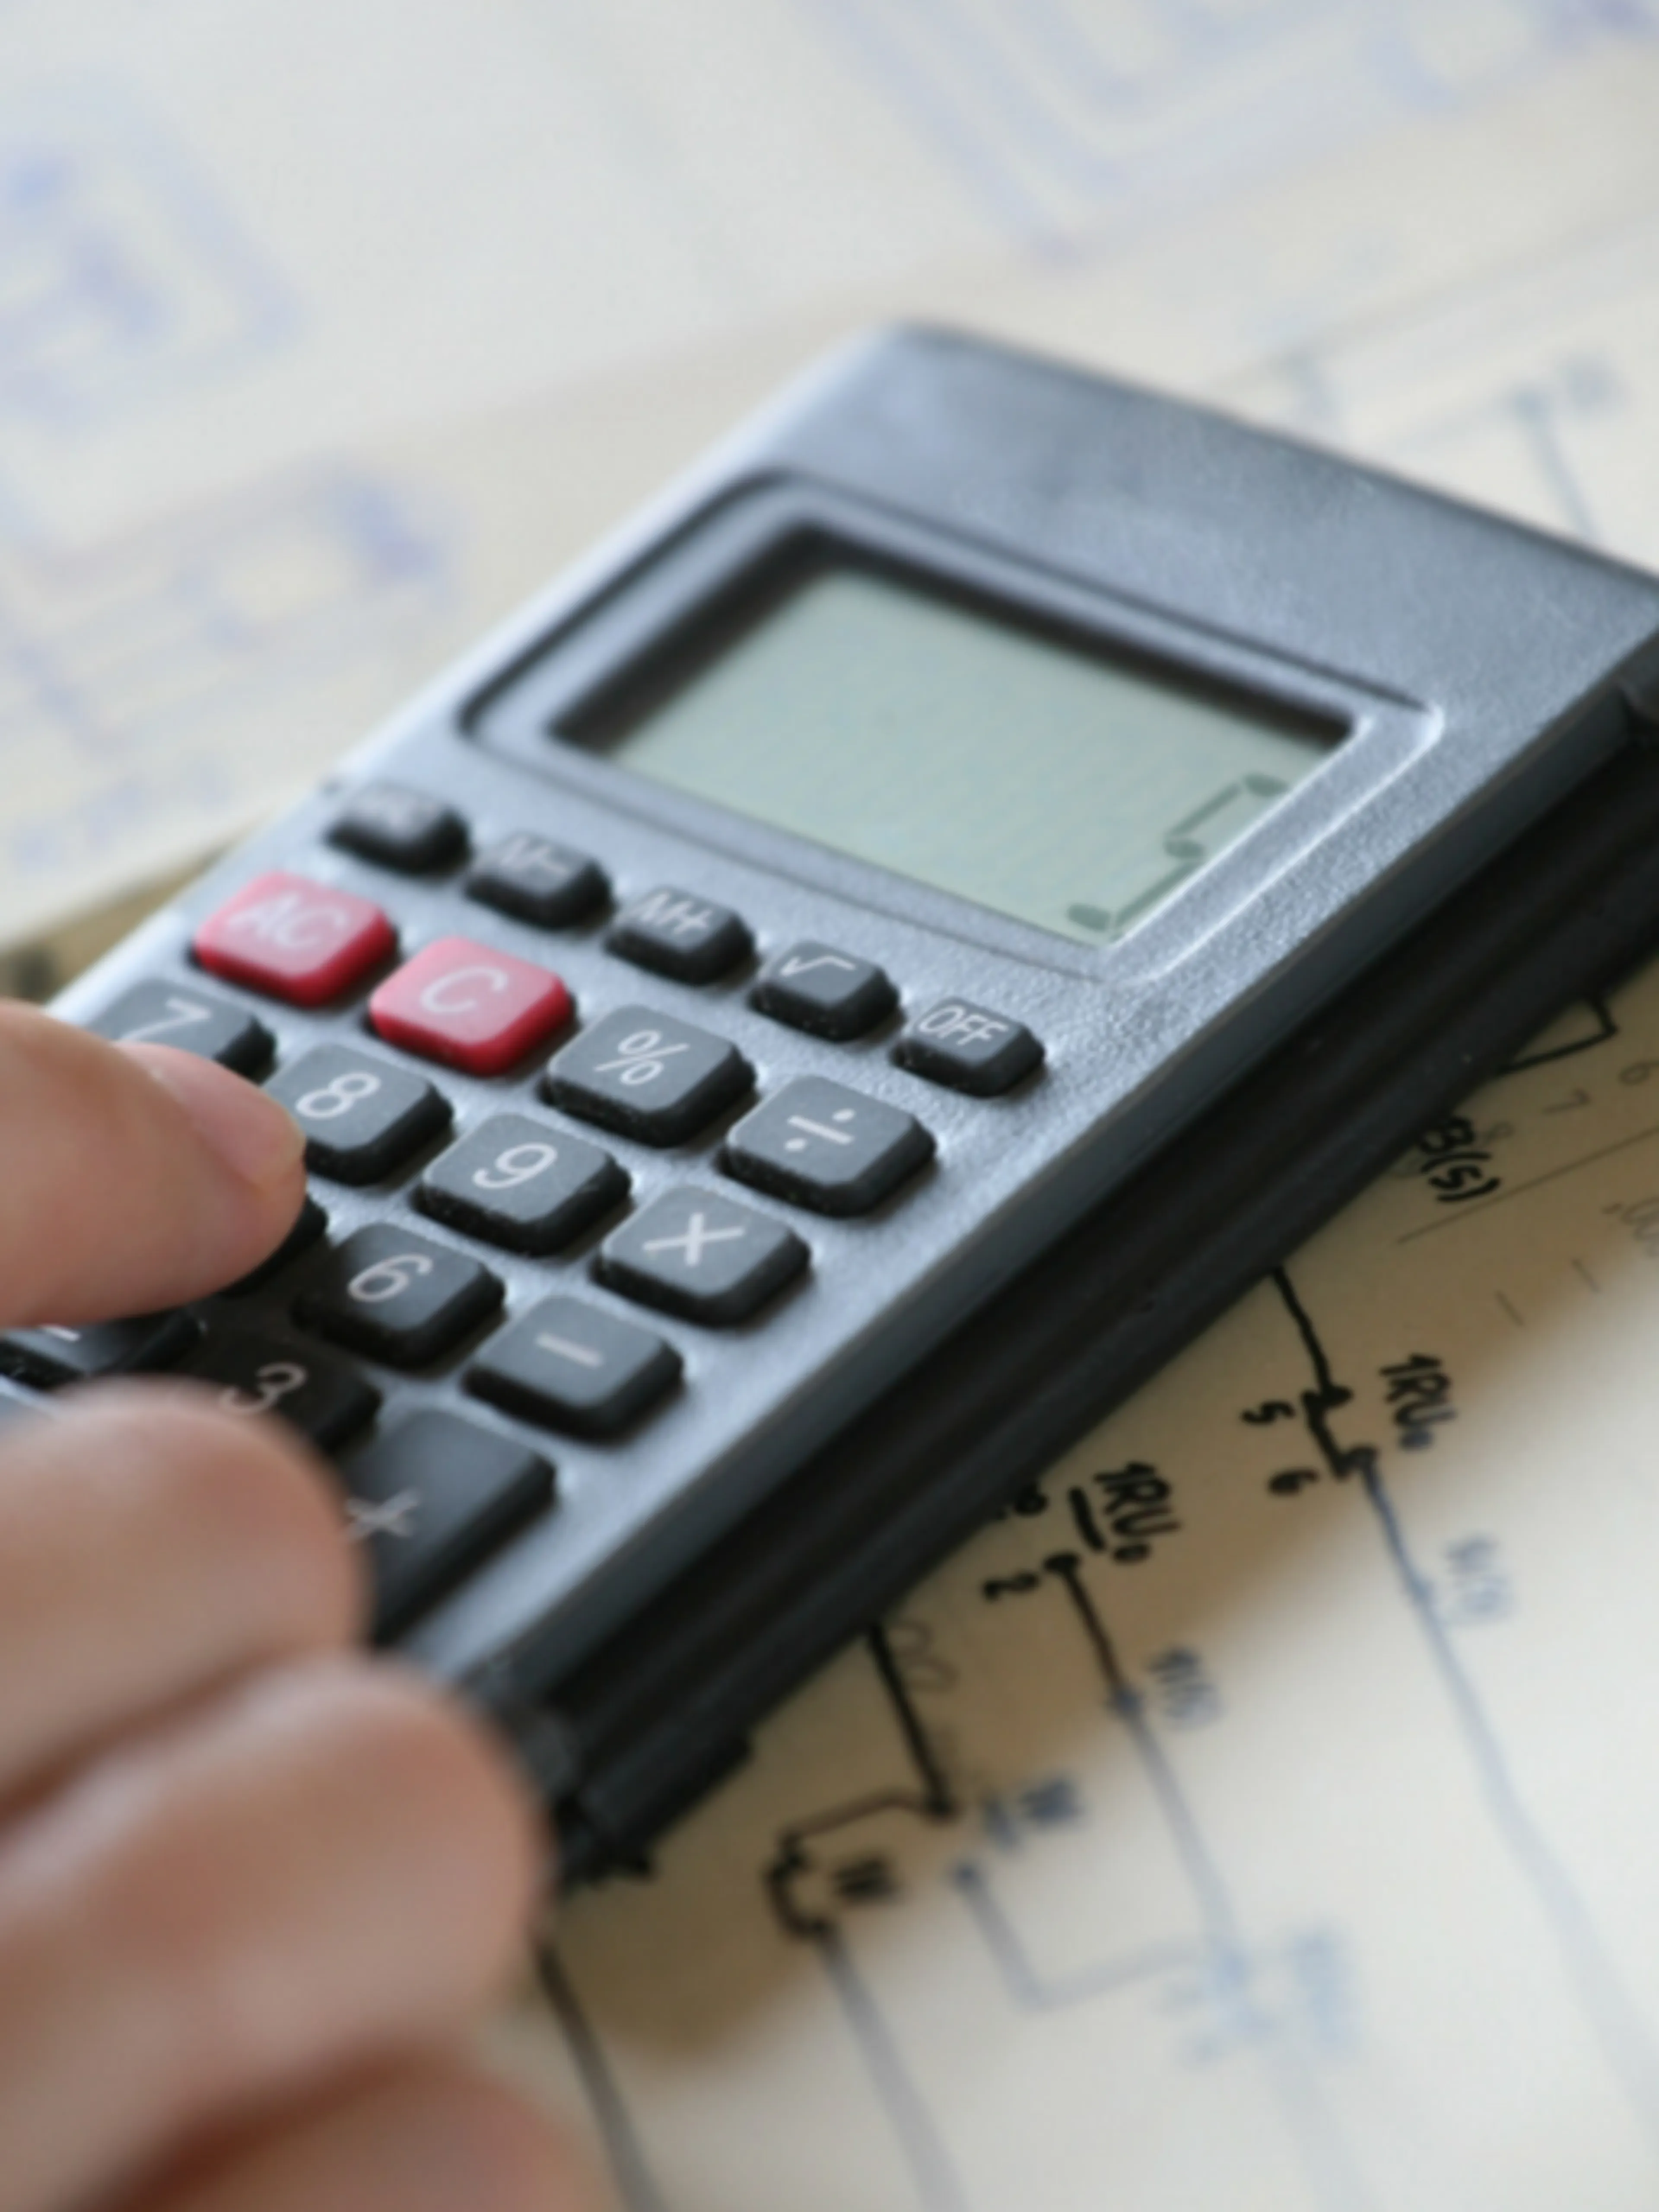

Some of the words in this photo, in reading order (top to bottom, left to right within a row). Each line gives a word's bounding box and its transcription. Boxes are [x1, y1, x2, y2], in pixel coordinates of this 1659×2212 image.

[226, 891, 348, 948] AC
[633, 889, 713, 934] M+
[419, 965, 510, 1014] C
[116, 997, 213, 1042] 7
[918, 1005, 1009, 1046] OFF
[594, 1028, 690, 1086] %
[294, 1071, 381, 1119] 8
[472, 1142, 558, 1189] 9
[348, 1254, 433, 1303] 6
[218, 1362, 308, 1415] 3
